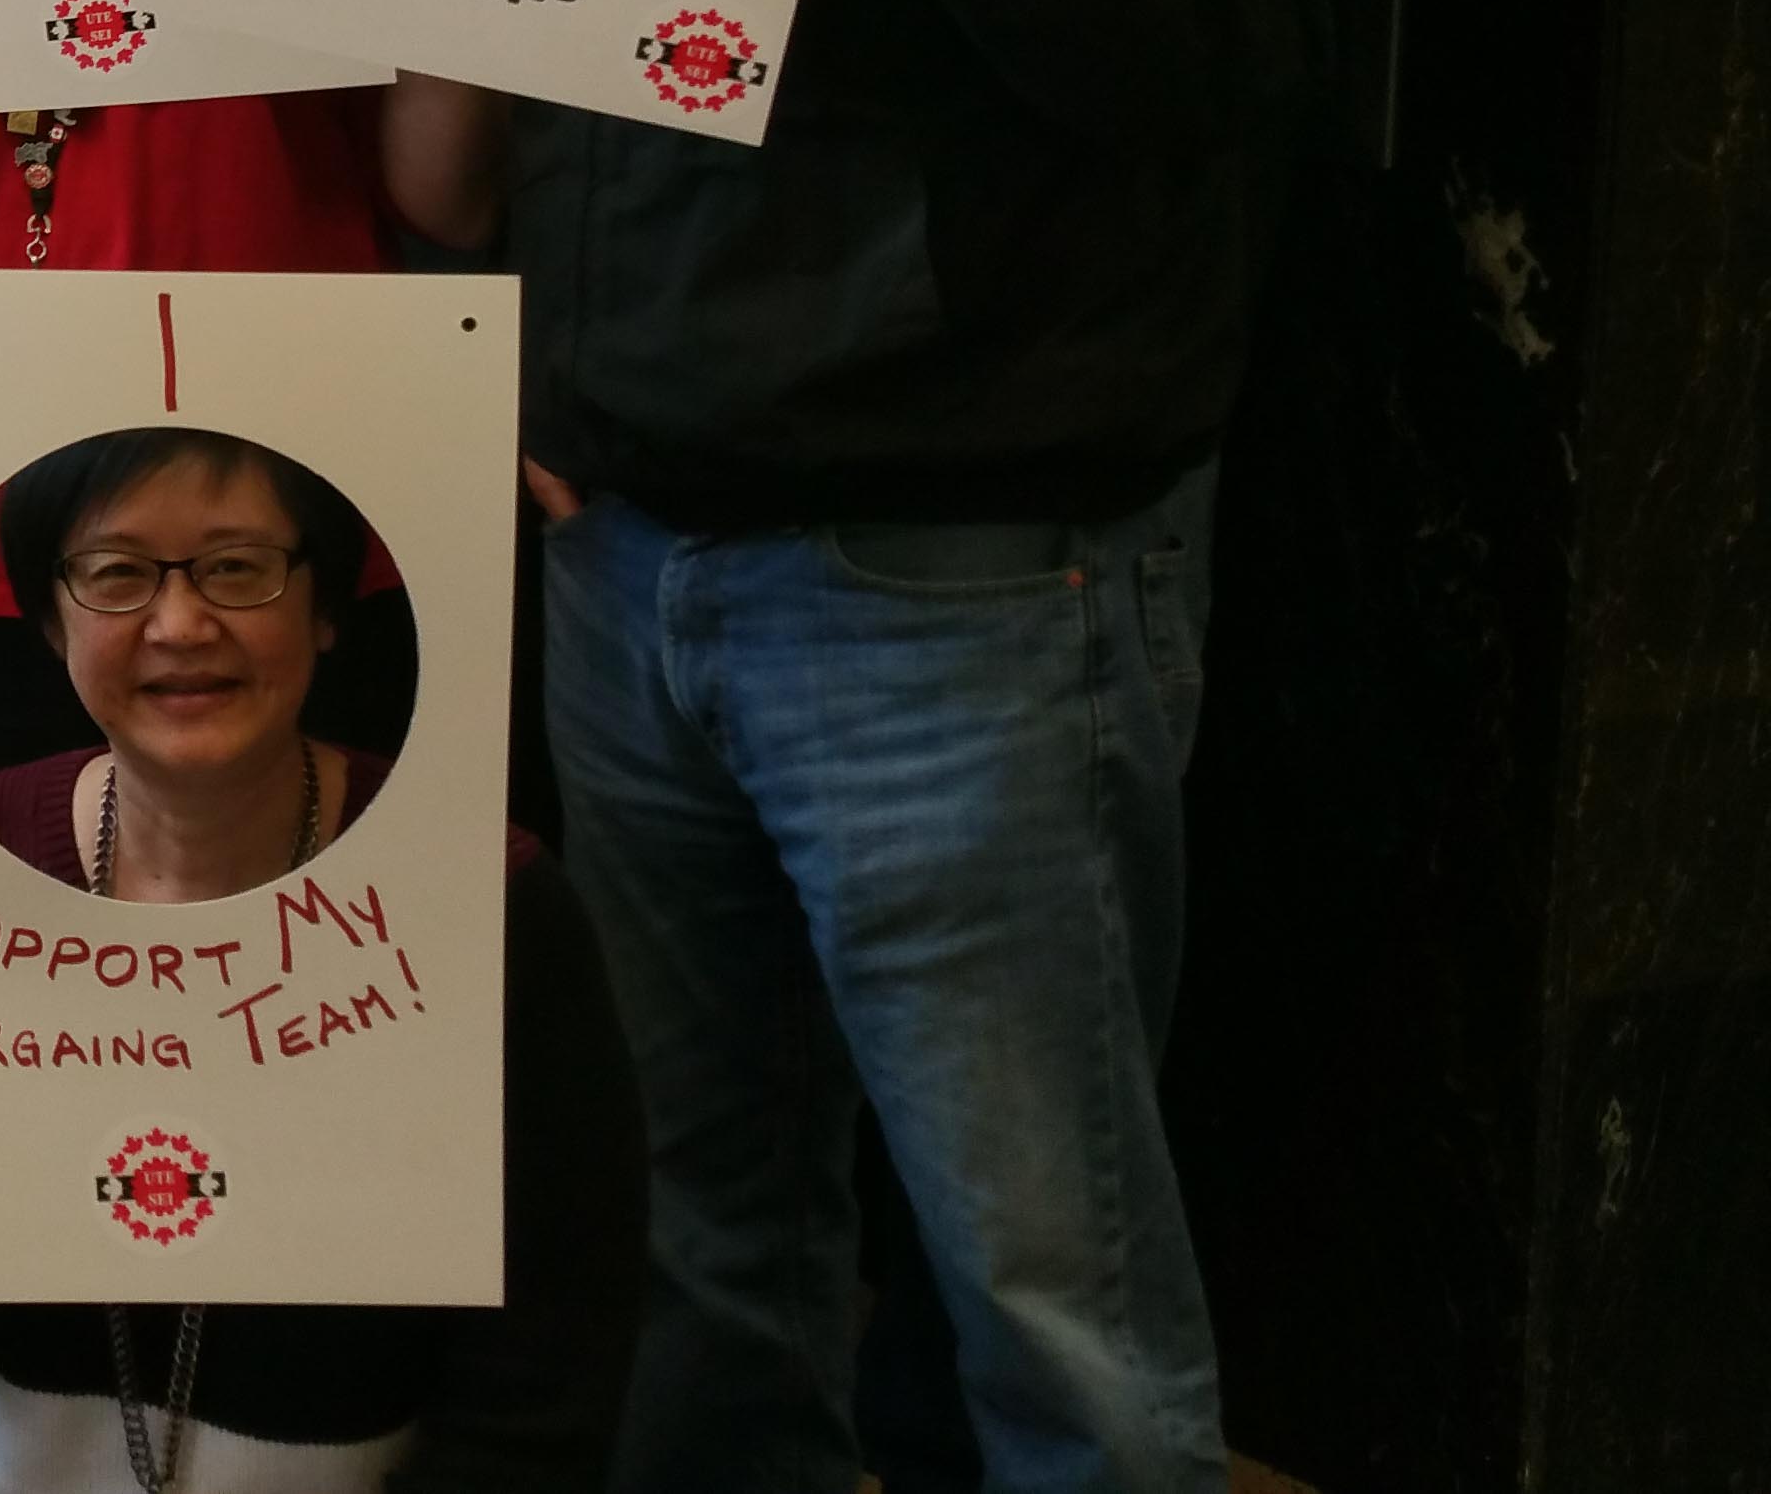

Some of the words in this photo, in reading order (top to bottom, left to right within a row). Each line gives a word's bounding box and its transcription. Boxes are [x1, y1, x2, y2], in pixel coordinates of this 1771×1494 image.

[85, 10, 112, 24] UTE
[89, 29, 112, 41] SEI
[685, 45, 718, 62] UTE
[217, 948, 425, 1066] TEAM!
[143, 1171, 175, 1187] UTE
[147, 1192, 174, 1207] SEI
